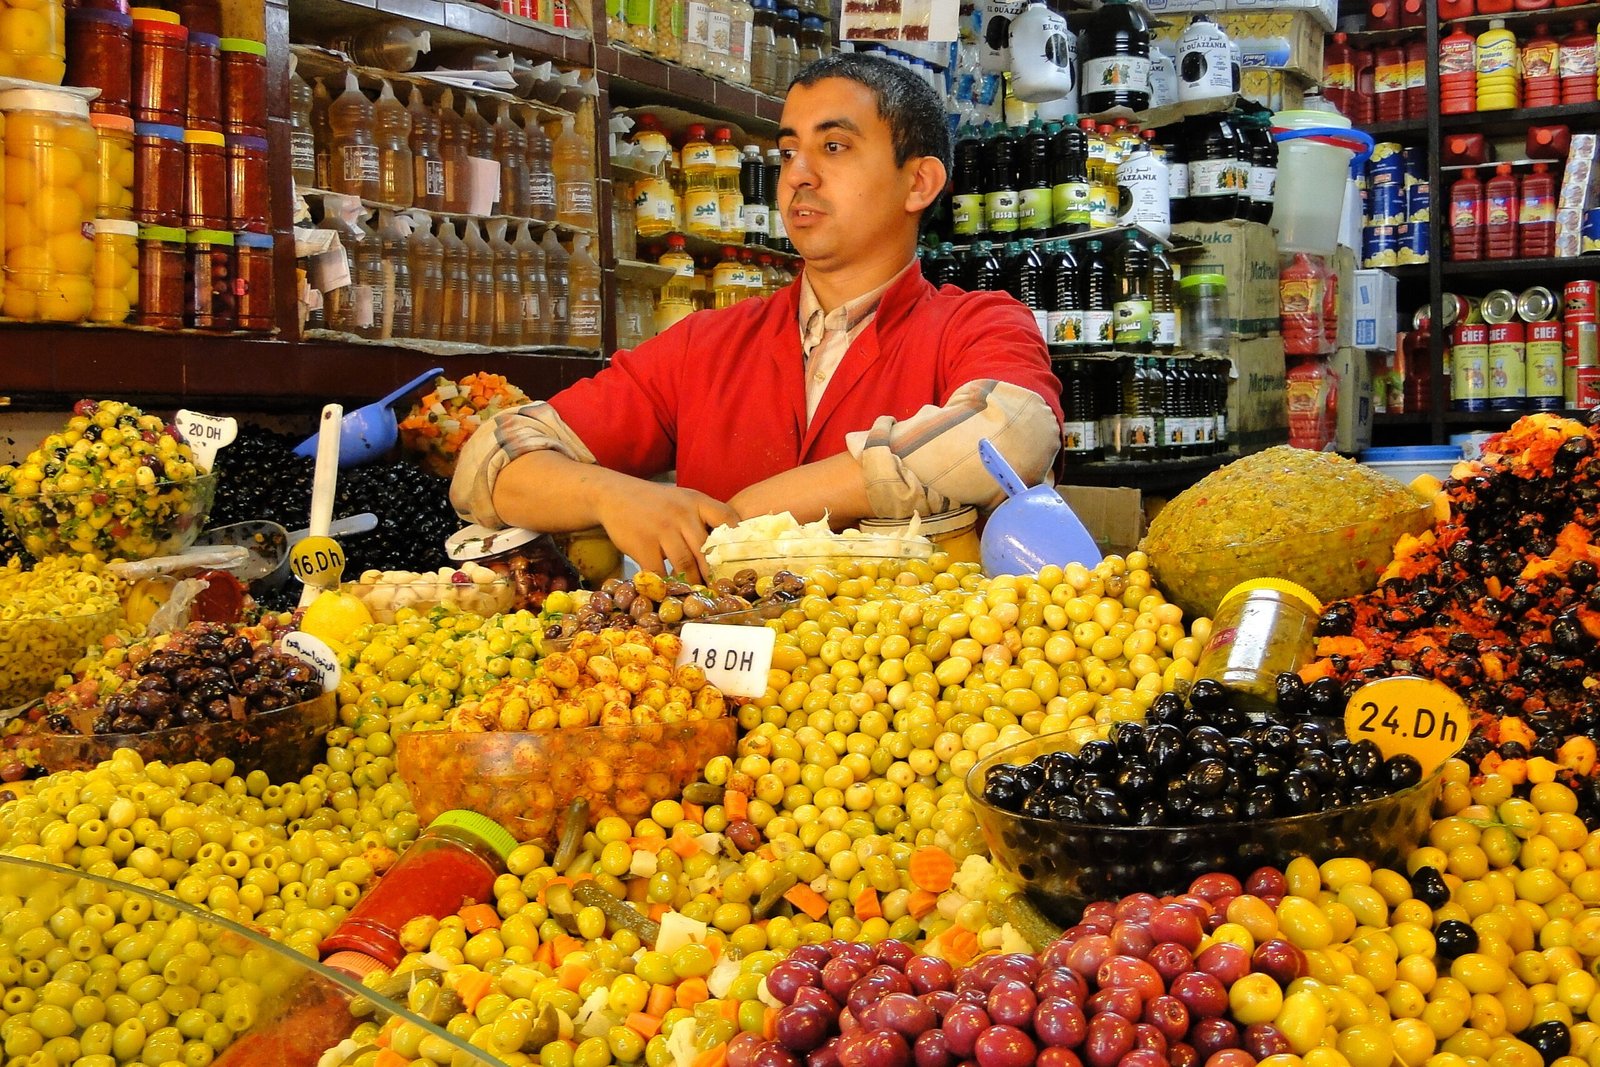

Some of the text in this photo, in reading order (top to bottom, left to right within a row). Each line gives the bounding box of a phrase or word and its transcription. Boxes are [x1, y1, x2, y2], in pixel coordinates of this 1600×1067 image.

[1187, 42, 1227, 50] OUAZZANIA
[991, 209, 1019, 219] Tassaw
[1461, 328, 1484, 343] CHEF
[1533, 326, 1557, 340] CHEF
[189, 422, 221, 441] 20 DH
[293, 548, 342, 577] 16.Dh
[692, 647, 754, 672] 18 DH
[1358, 701, 1458, 743] 24.Dh
